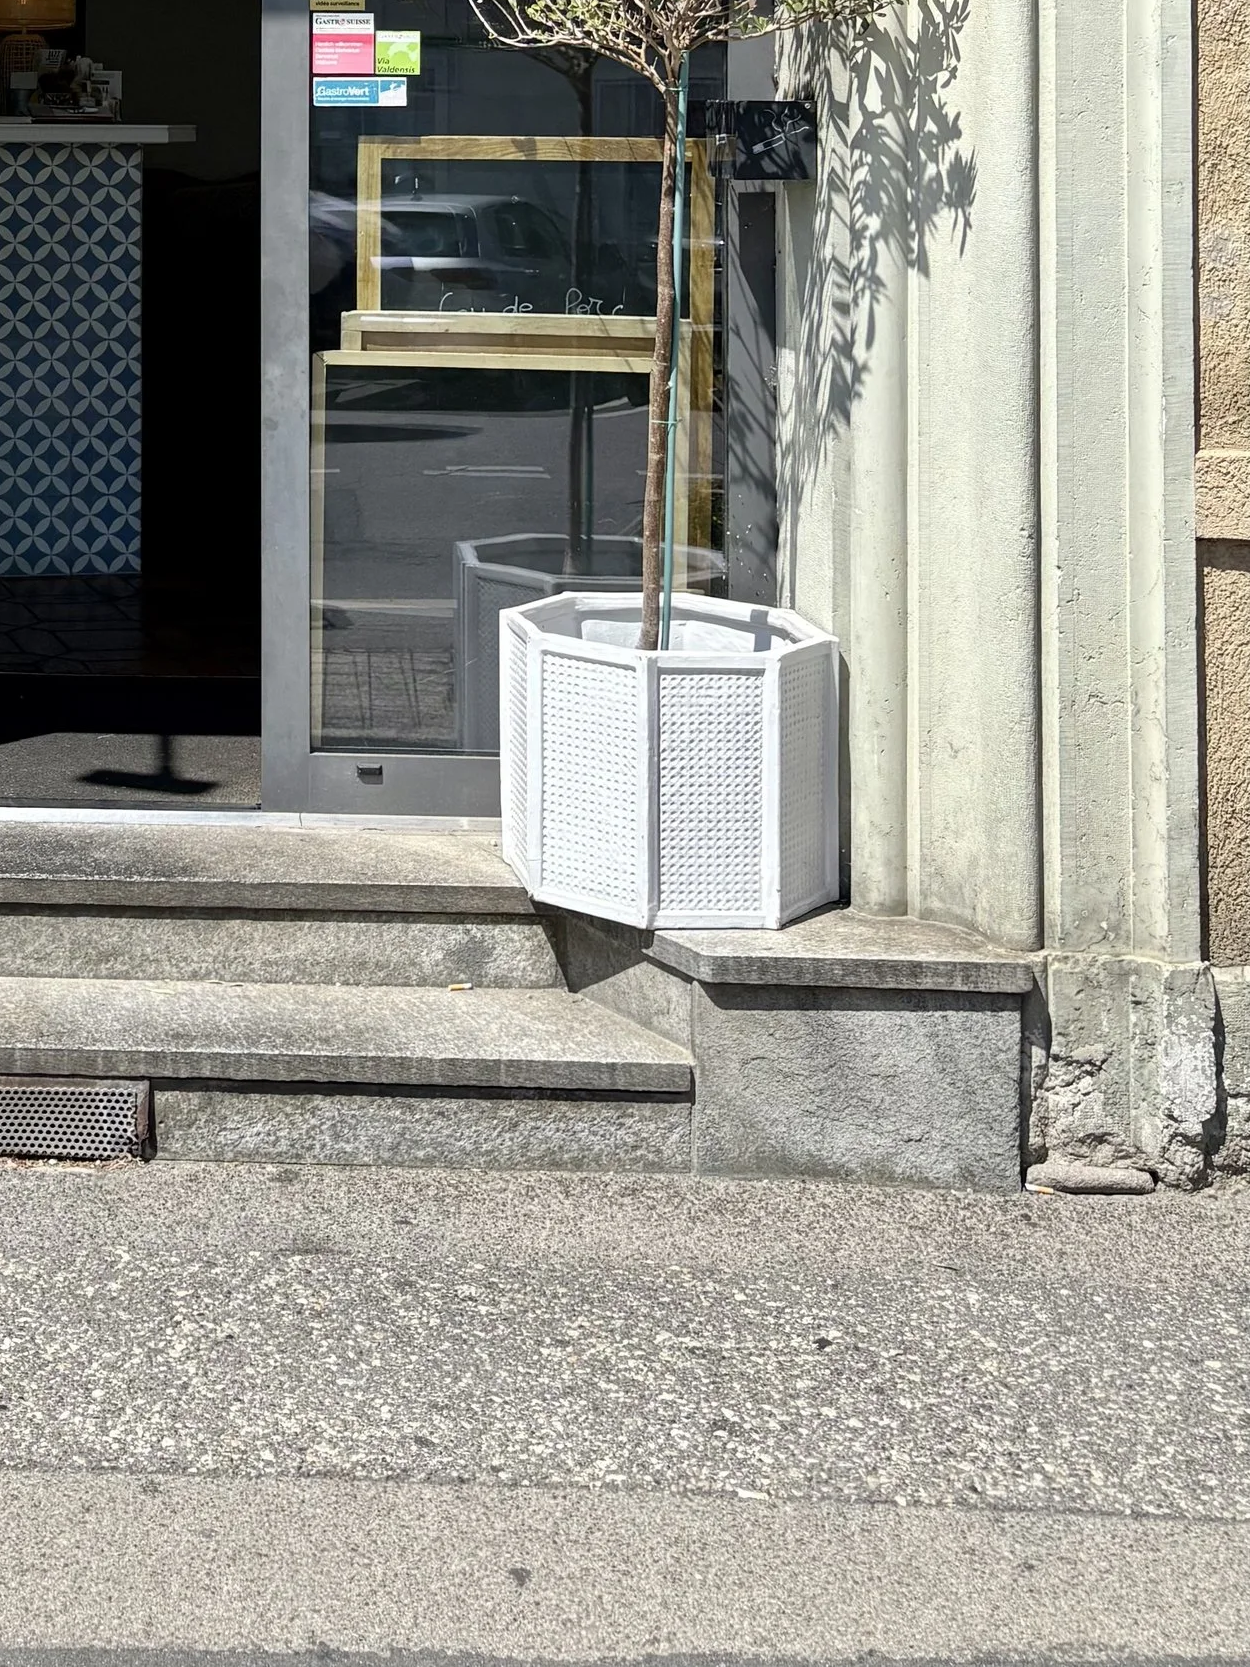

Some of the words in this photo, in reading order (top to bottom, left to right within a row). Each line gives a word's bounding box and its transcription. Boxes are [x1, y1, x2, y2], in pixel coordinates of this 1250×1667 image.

[377, 57, 390, 65] Via
[377, 65, 416, 74] Valdensis
[316, 86, 370, 96] GastroVert
